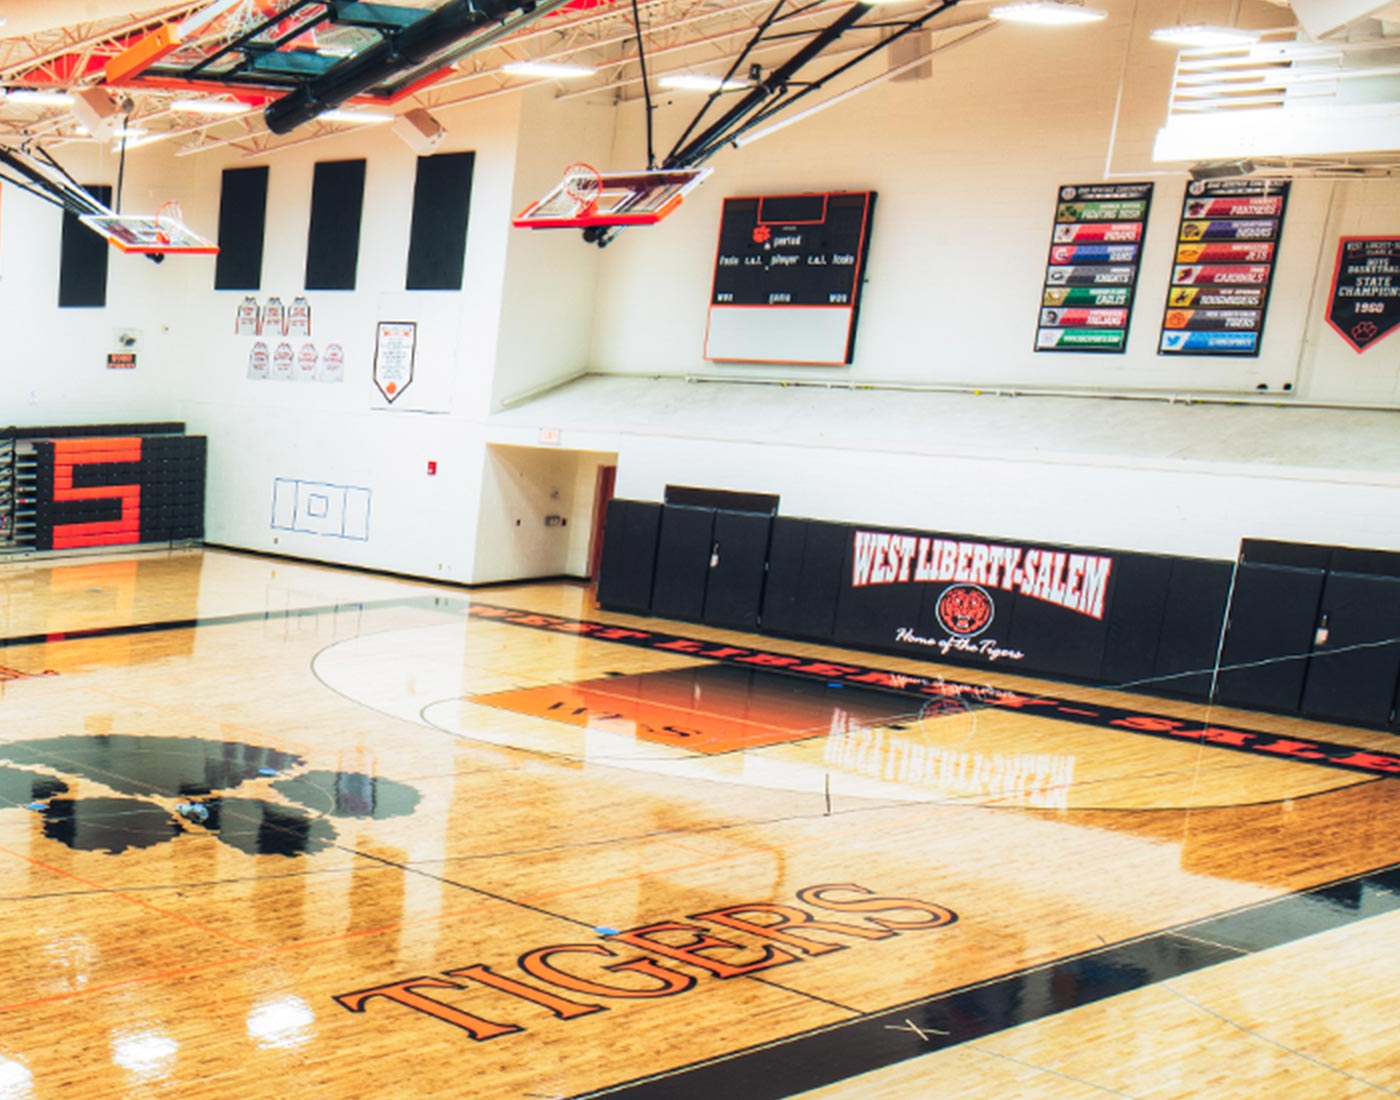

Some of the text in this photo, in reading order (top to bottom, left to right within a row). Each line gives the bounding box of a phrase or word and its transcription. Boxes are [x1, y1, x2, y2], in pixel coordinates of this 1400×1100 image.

[852, 530, 1112, 620] WEST LIBERTY-SALEM
[464, 602, 651, 640] WEST
[895, 627, 1024, 661] Home of the Tigers
[332, 883, 959, 1042] TIGERS
